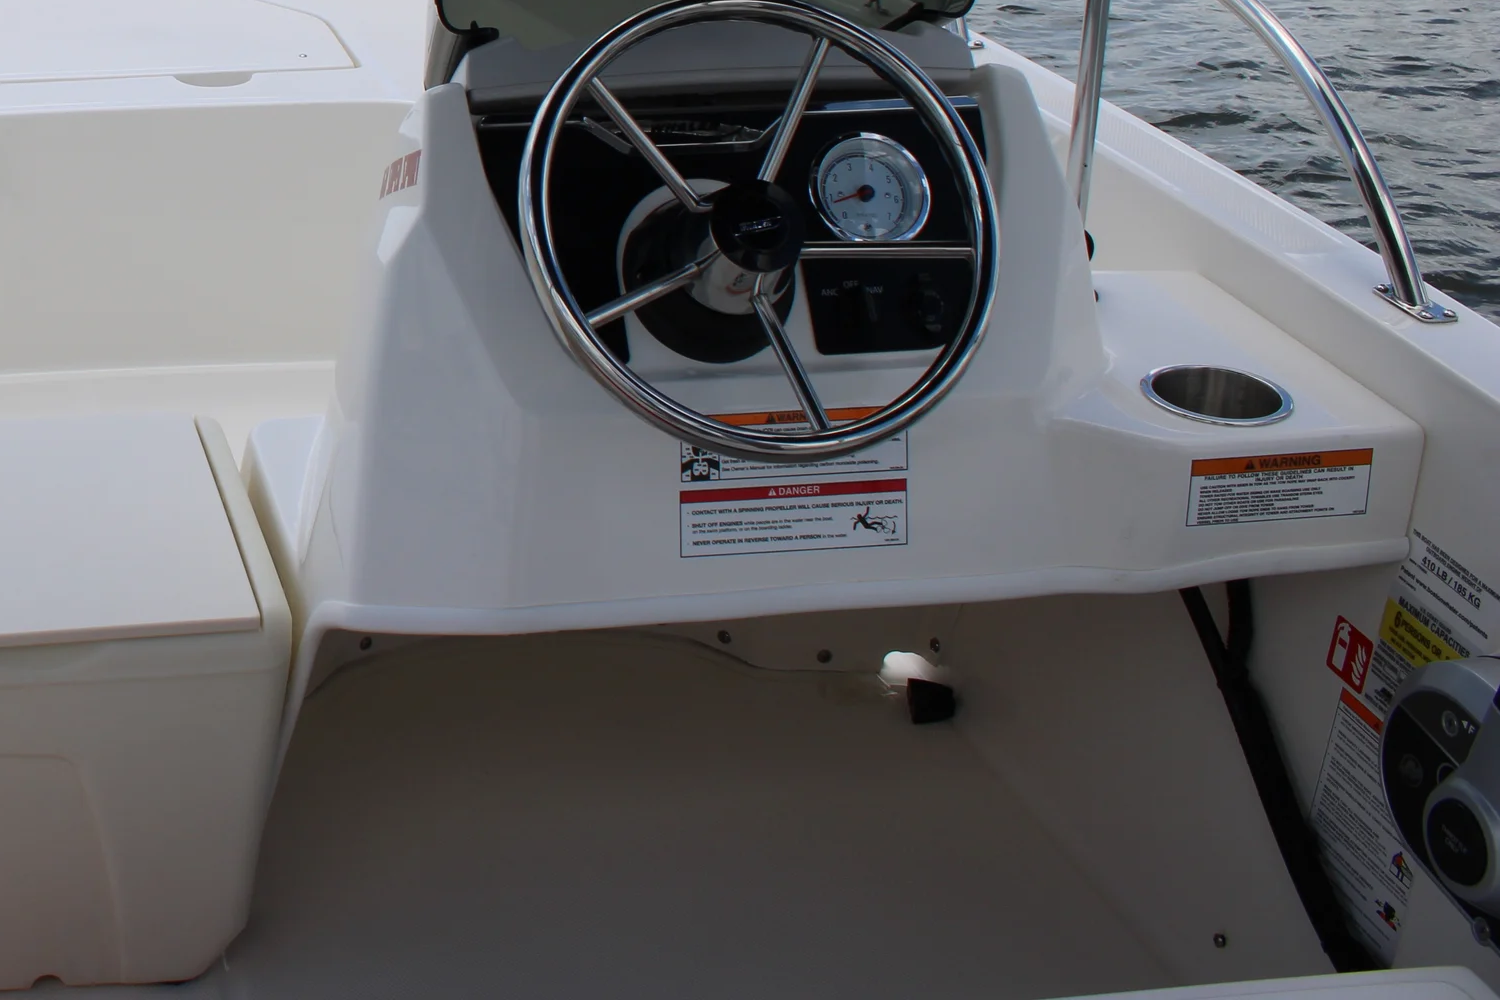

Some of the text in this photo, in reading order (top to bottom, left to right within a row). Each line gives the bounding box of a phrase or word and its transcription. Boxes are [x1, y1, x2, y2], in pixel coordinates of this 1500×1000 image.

[842, 279, 859, 288] OFF
[865, 285, 884, 294] NAV
[1259, 455, 1321, 468] WARNING
[778, 485, 820, 496] DANGER
[1421, 535, 1432, 546] BOAT
[1440, 549, 1450, 561] BEEN
[1450, 558, 1469, 576] DESIGNED
[1469, 573, 1478, 583] FOR
[1401, 565, 1415, 580] Patent
[1426, 546, 1446, 566] OUTBOARD
[1447, 563, 1461, 578] ENGINE
[1461, 574, 1476, 589] WEIGHT
[1422, 556, 1435, 571] 410
[1436, 567, 1447, 581] LB
[1454, 580, 1467, 597] 185
[1468, 592, 1481, 608] KG
[1394, 611, 1402, 628] 6
[1401, 619, 1431, 649] PERSONS
[1431, 644, 1442, 657] OR
[1398, 596, 1429, 627] MAXIMUM
[1430, 623, 1471, 658] CAPACITIES
[1468, 724, 1475, 735] F
